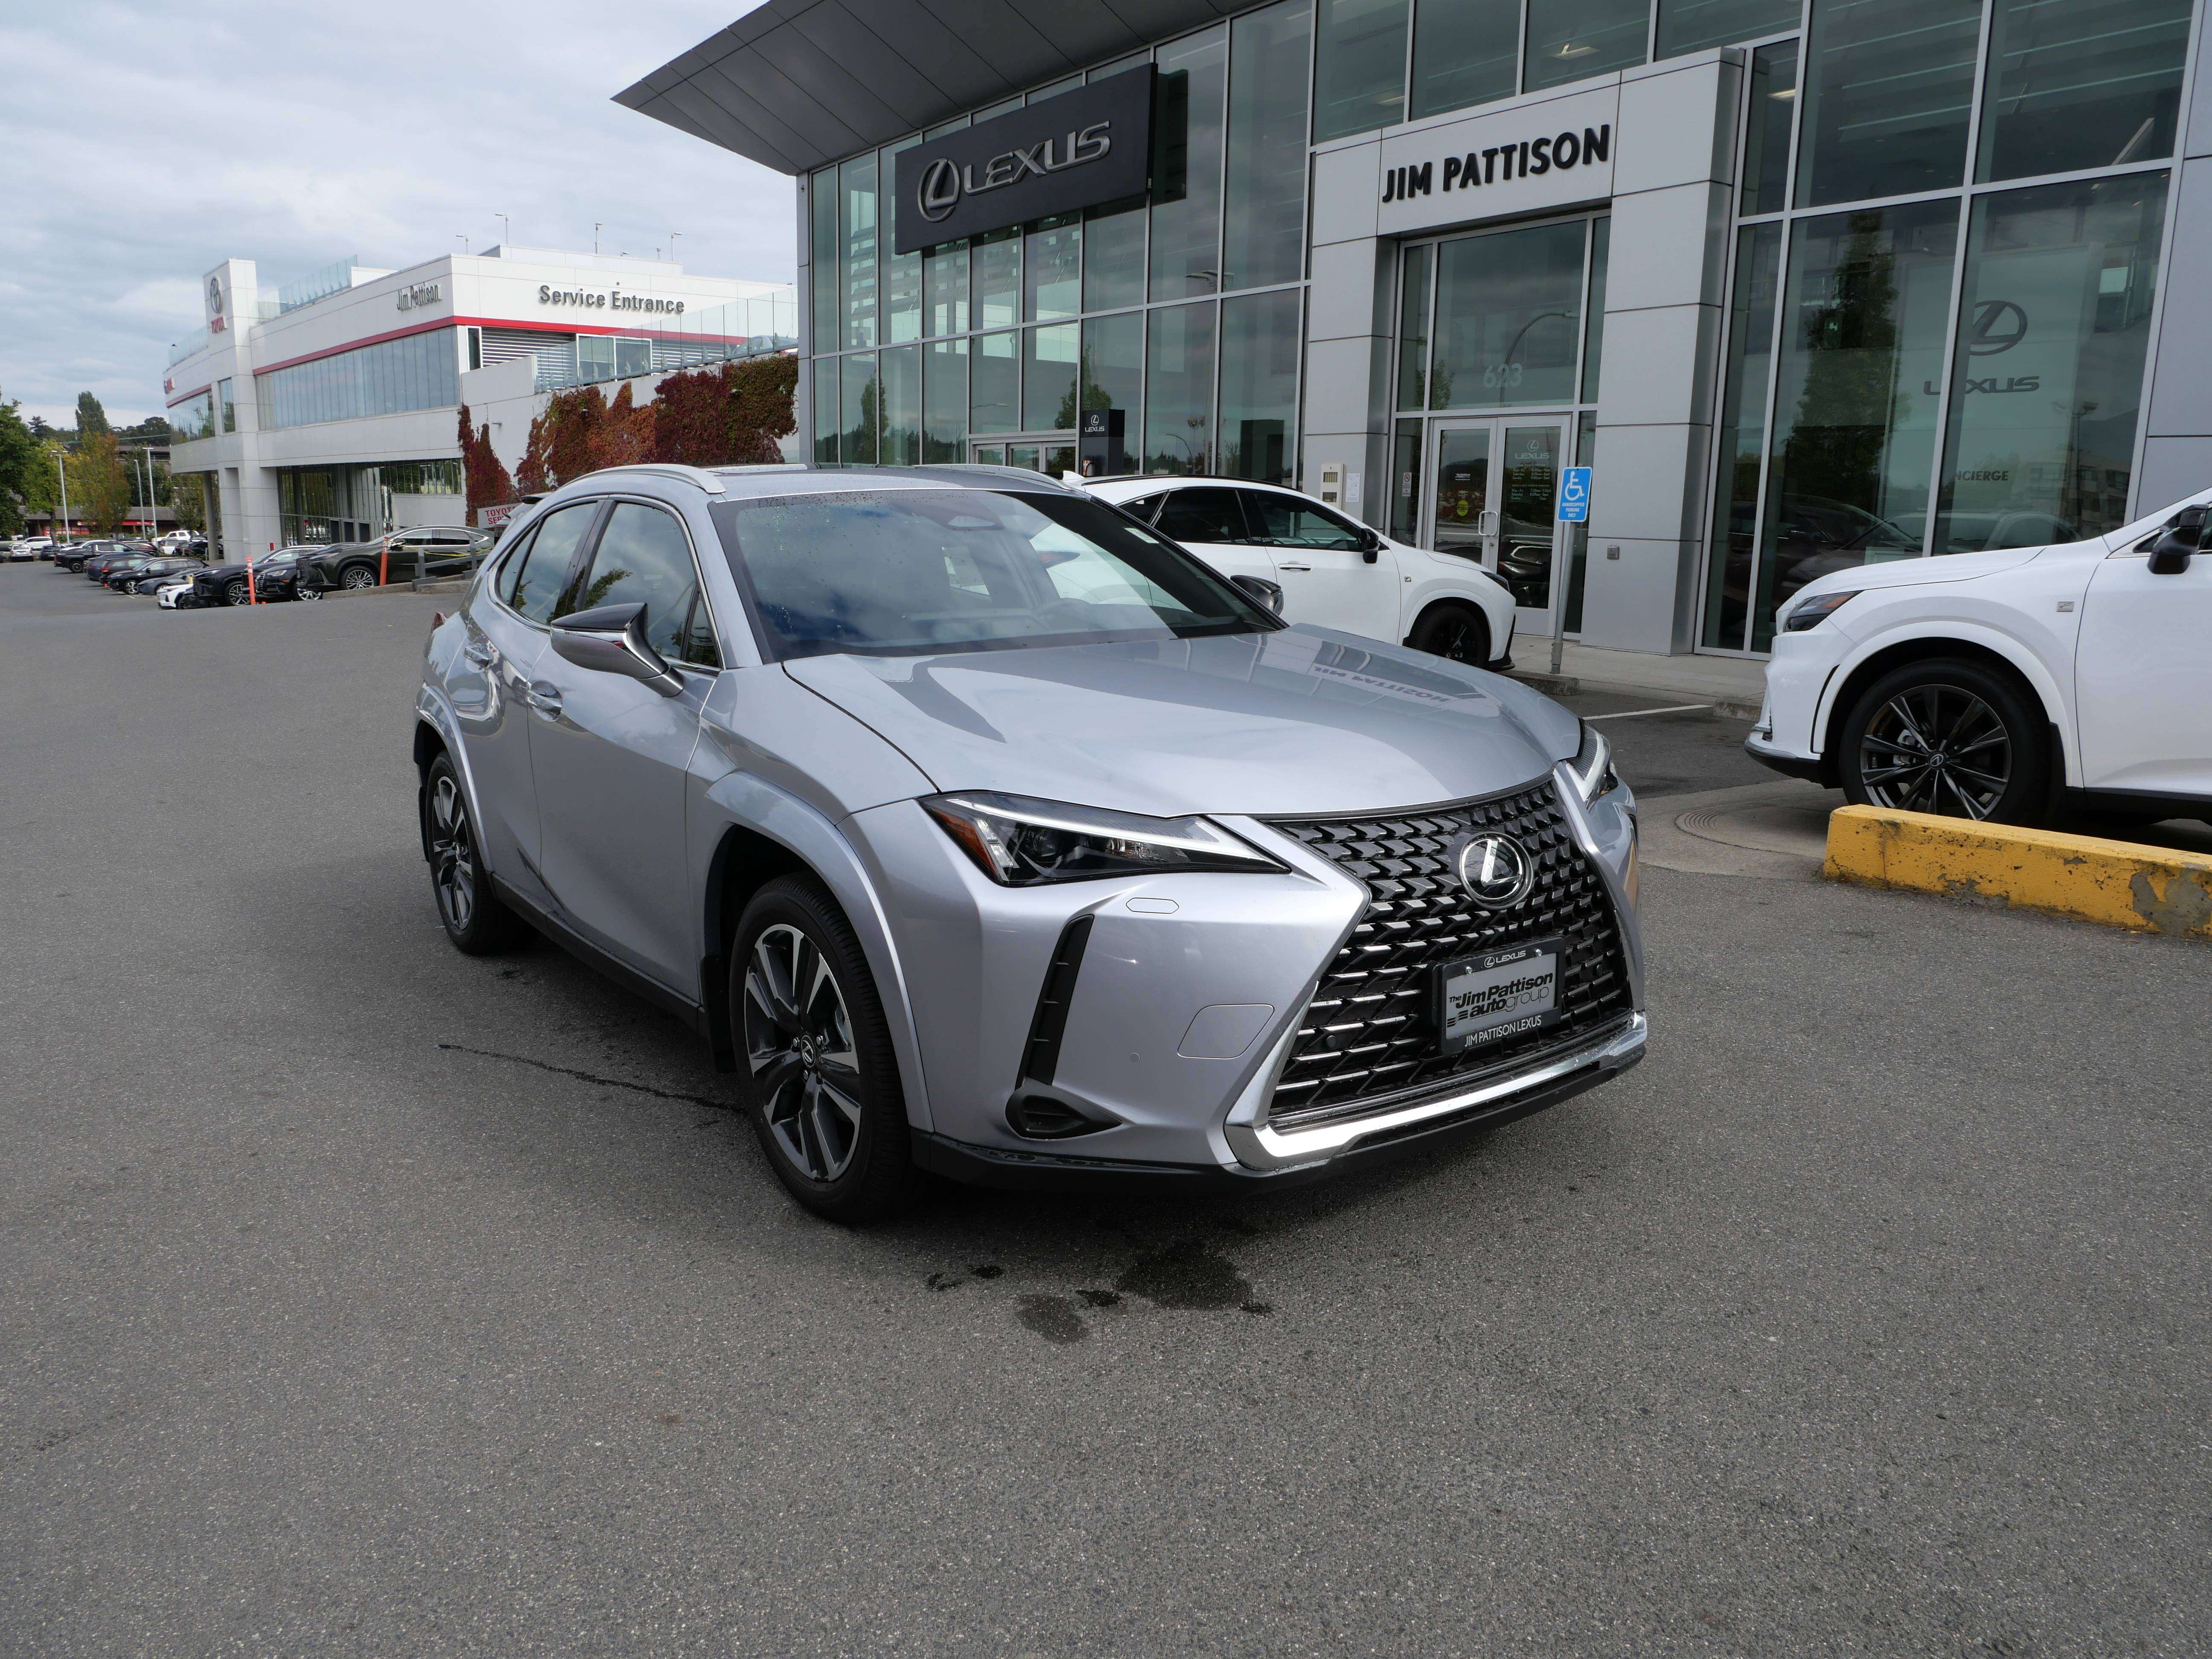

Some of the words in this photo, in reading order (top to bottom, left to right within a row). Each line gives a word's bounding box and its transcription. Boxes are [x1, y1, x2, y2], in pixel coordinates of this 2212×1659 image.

[964, 120, 1110, 196] LEXUS
[1382, 161, 1433, 203] JIM
[1443, 124, 1611, 192] PATTISON
[397, 288, 410, 311] Jim
[410, 282, 439, 307] Pattison
[538, 285, 606, 308] Service
[611, 291, 685, 313] Entrance
[1484, 363, 1523, 388] 623
[1924, 376, 2040, 396] LXUS
[485, 506, 515, 517] TOYOT
[1496, 950, 1526, 963] LEXUS
[1449, 995, 1461, 1003] The
[1465, 1033, 1477, 1047] JIM
[1479, 1022, 1516, 1042] PATTISON
[1517, 1015, 1541, 1031] LEXUS
